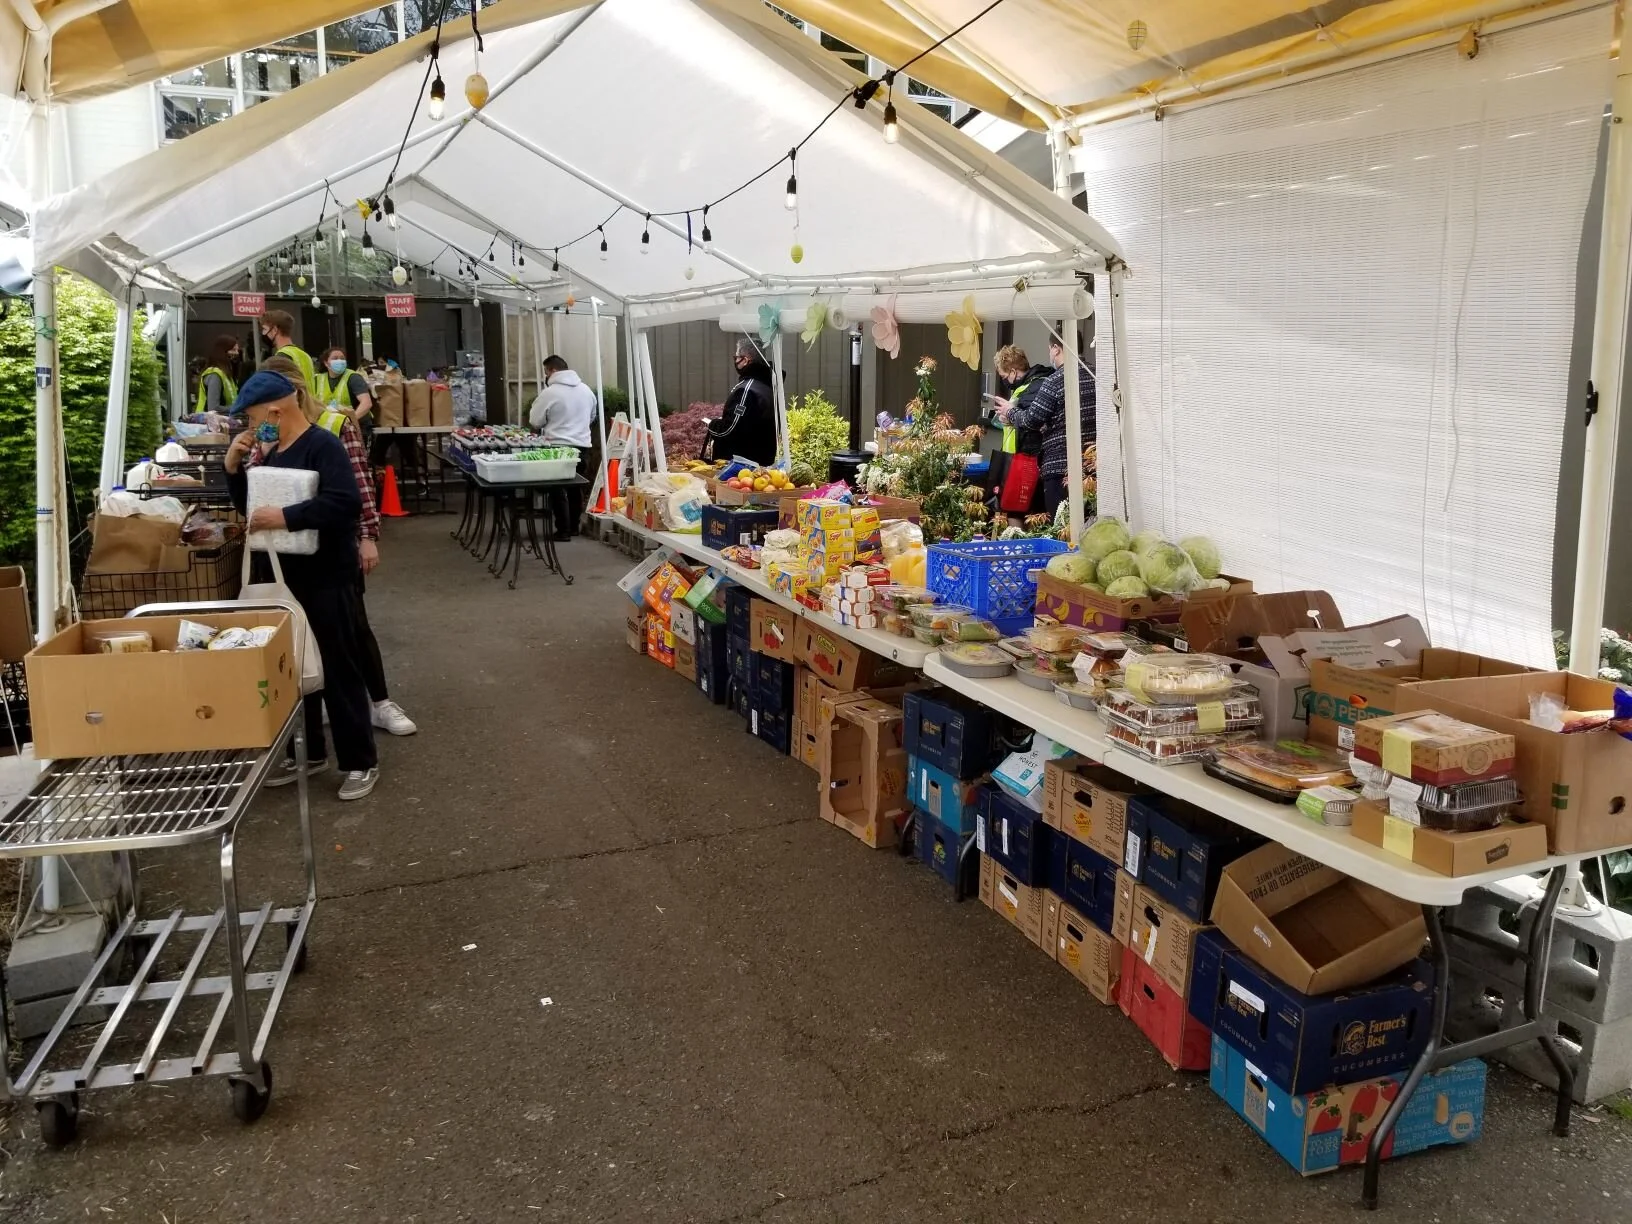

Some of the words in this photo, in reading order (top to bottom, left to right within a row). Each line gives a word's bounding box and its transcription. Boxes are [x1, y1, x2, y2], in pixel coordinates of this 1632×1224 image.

[237, 296, 262, 304] STAFF
[389, 297, 411, 305] STAFF
[238, 306, 262, 314] ONLY
[391, 306, 412, 314] ONLY
[1018, 756, 1038, 768] HONEST
[1272, 862, 1289, 876] WITH
[1255, 868, 1274, 884] KNIFE
[1268, 881, 1278, 892] OR
[1368, 1014, 1407, 1034] Farmer's
[1366, 1034, 1386, 1049] Best
[1333, 1052, 1405, 1073] CUCUMBERS
